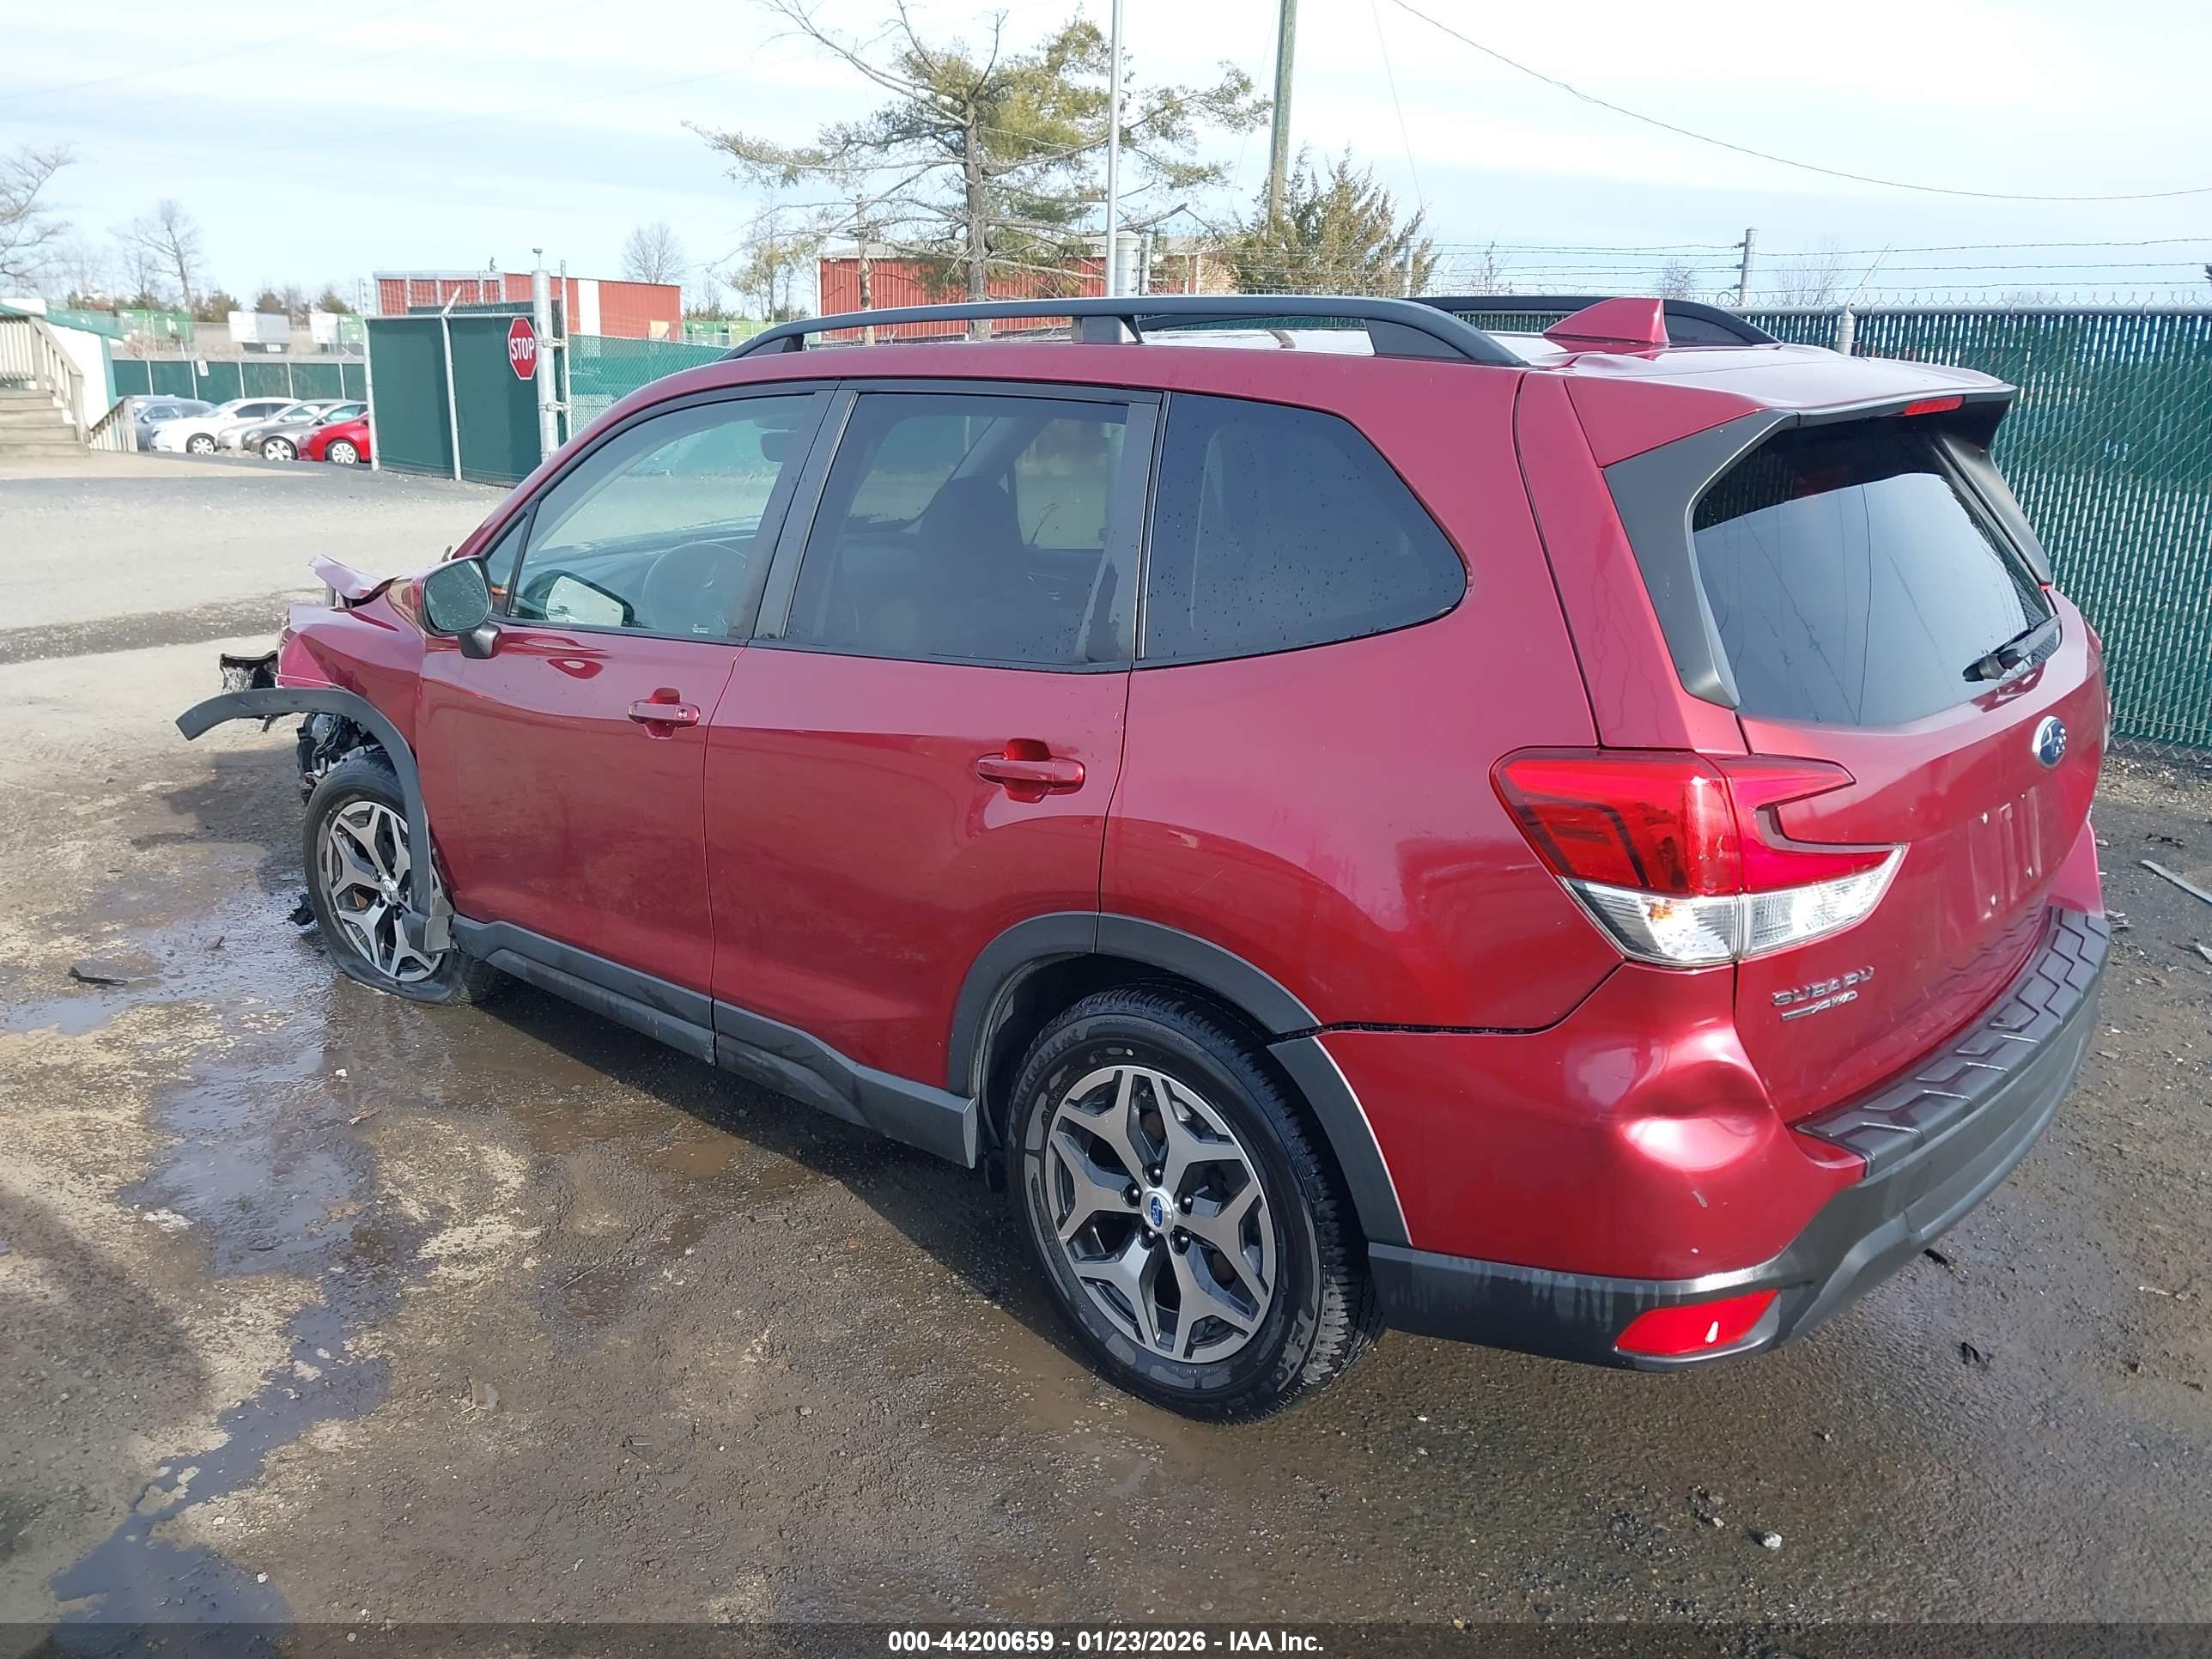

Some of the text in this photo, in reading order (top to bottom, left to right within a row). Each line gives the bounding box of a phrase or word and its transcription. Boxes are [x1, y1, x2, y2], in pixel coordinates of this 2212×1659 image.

[511, 337, 535, 361] STOP
[1772, 965, 1875, 1006] SUBARU
[1782, 990, 1858, 1021] AWD
